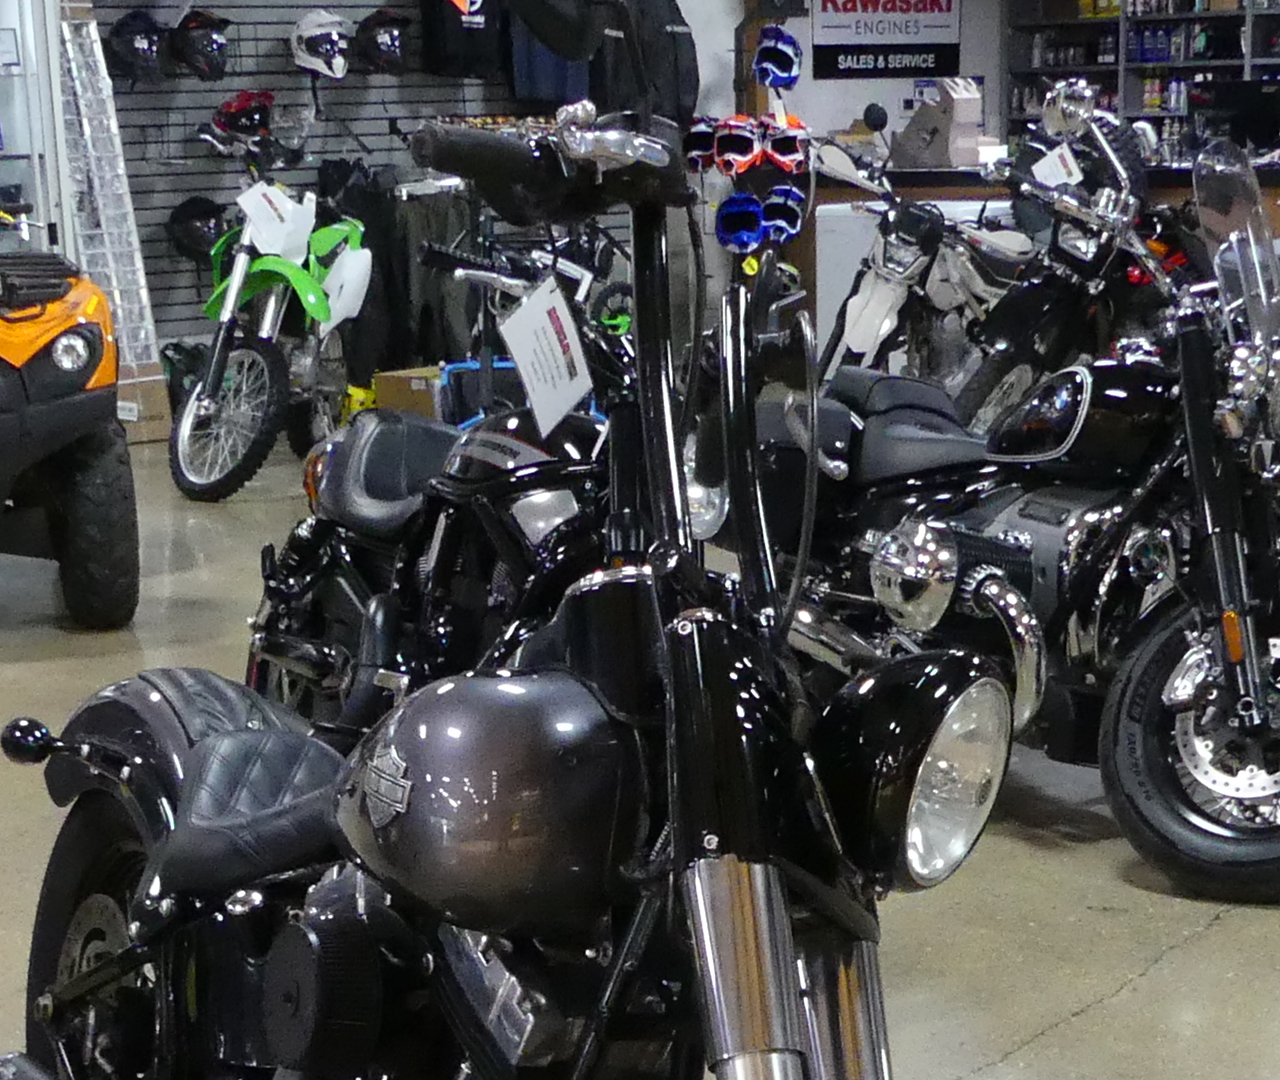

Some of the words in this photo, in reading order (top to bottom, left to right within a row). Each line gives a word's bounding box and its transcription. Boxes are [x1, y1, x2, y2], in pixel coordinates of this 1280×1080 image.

[854, 19, 920, 35] ENGINES
[837, 54, 875, 70] SALES
[877, 55, 885, 69] &
[888, 53, 936, 69] SERVICE
